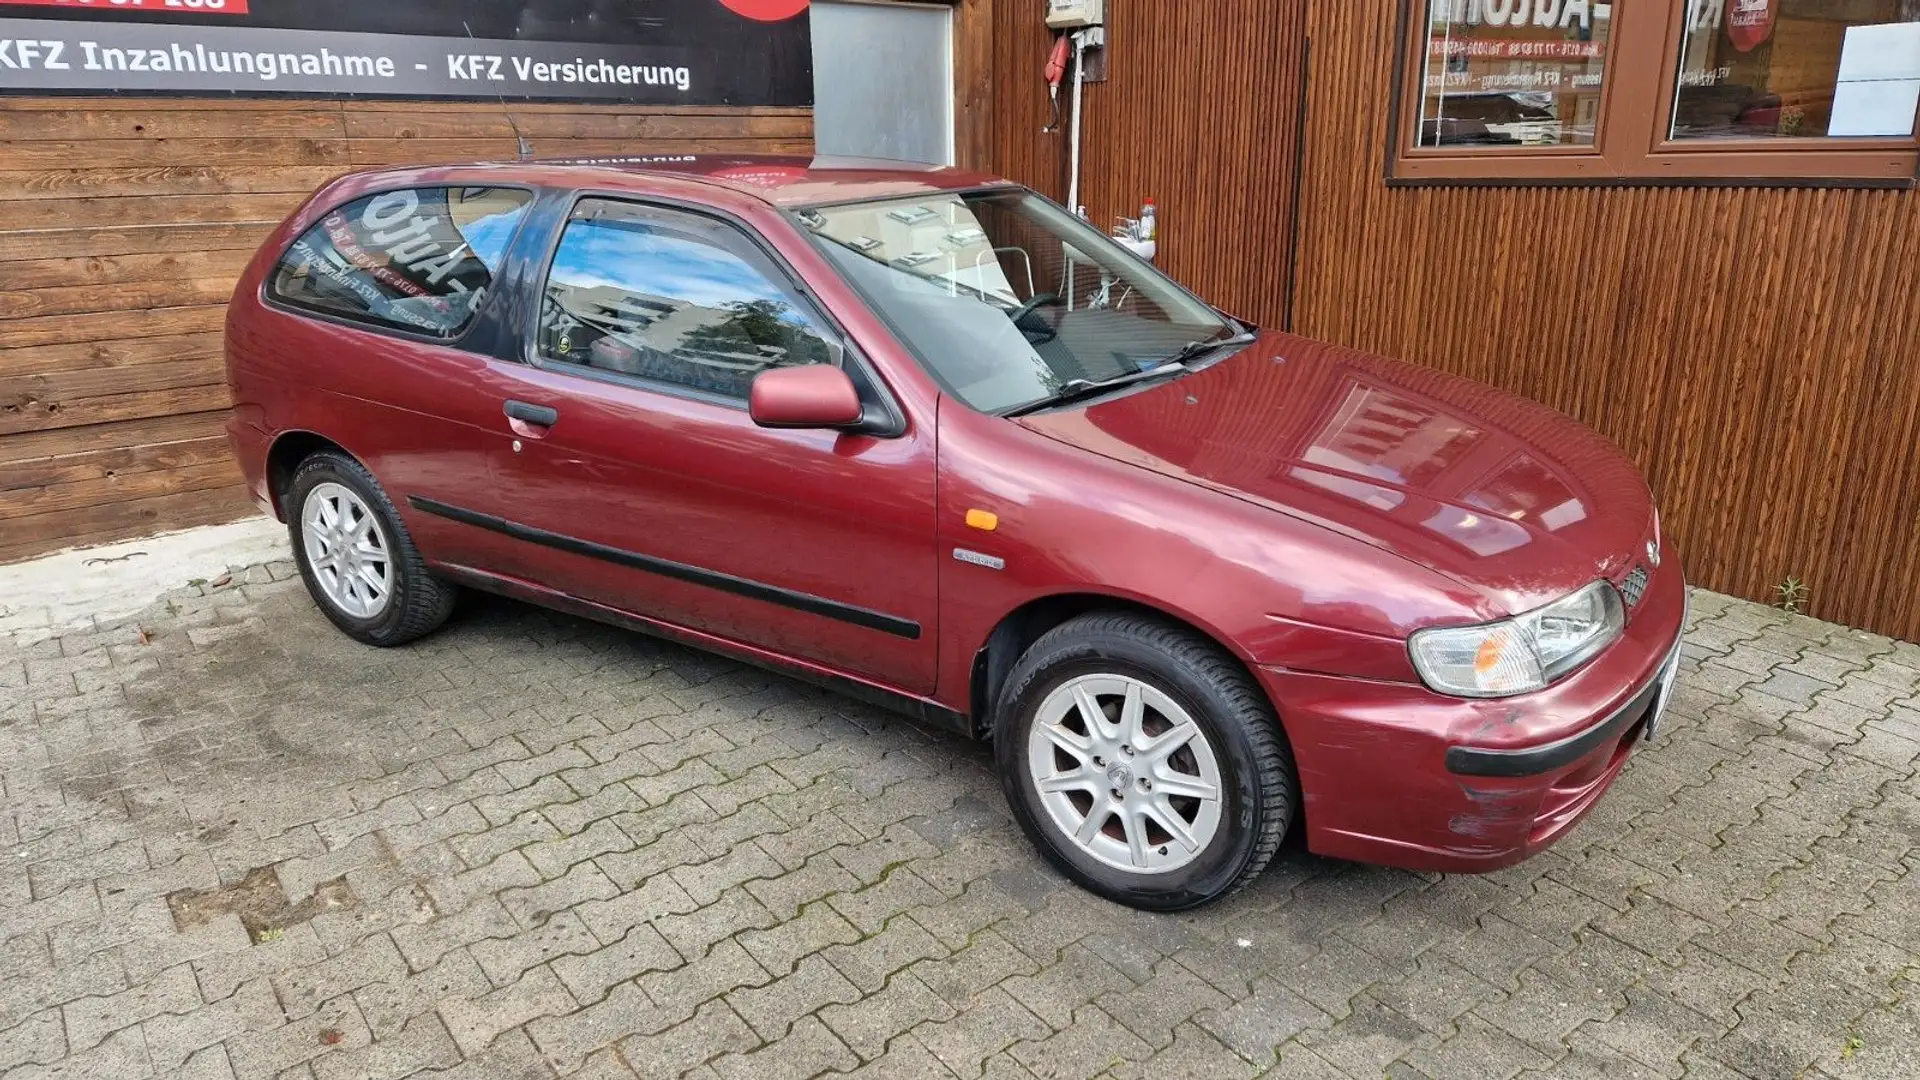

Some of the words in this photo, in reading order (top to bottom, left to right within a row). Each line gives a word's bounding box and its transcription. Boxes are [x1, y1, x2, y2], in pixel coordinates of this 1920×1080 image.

[0, 39, 70, 70] KFZ
[79, 42, 395, 81] Inzahlungnahme
[448, 54, 505, 81] KFZ
[511, 56, 690, 90] Versicherung
